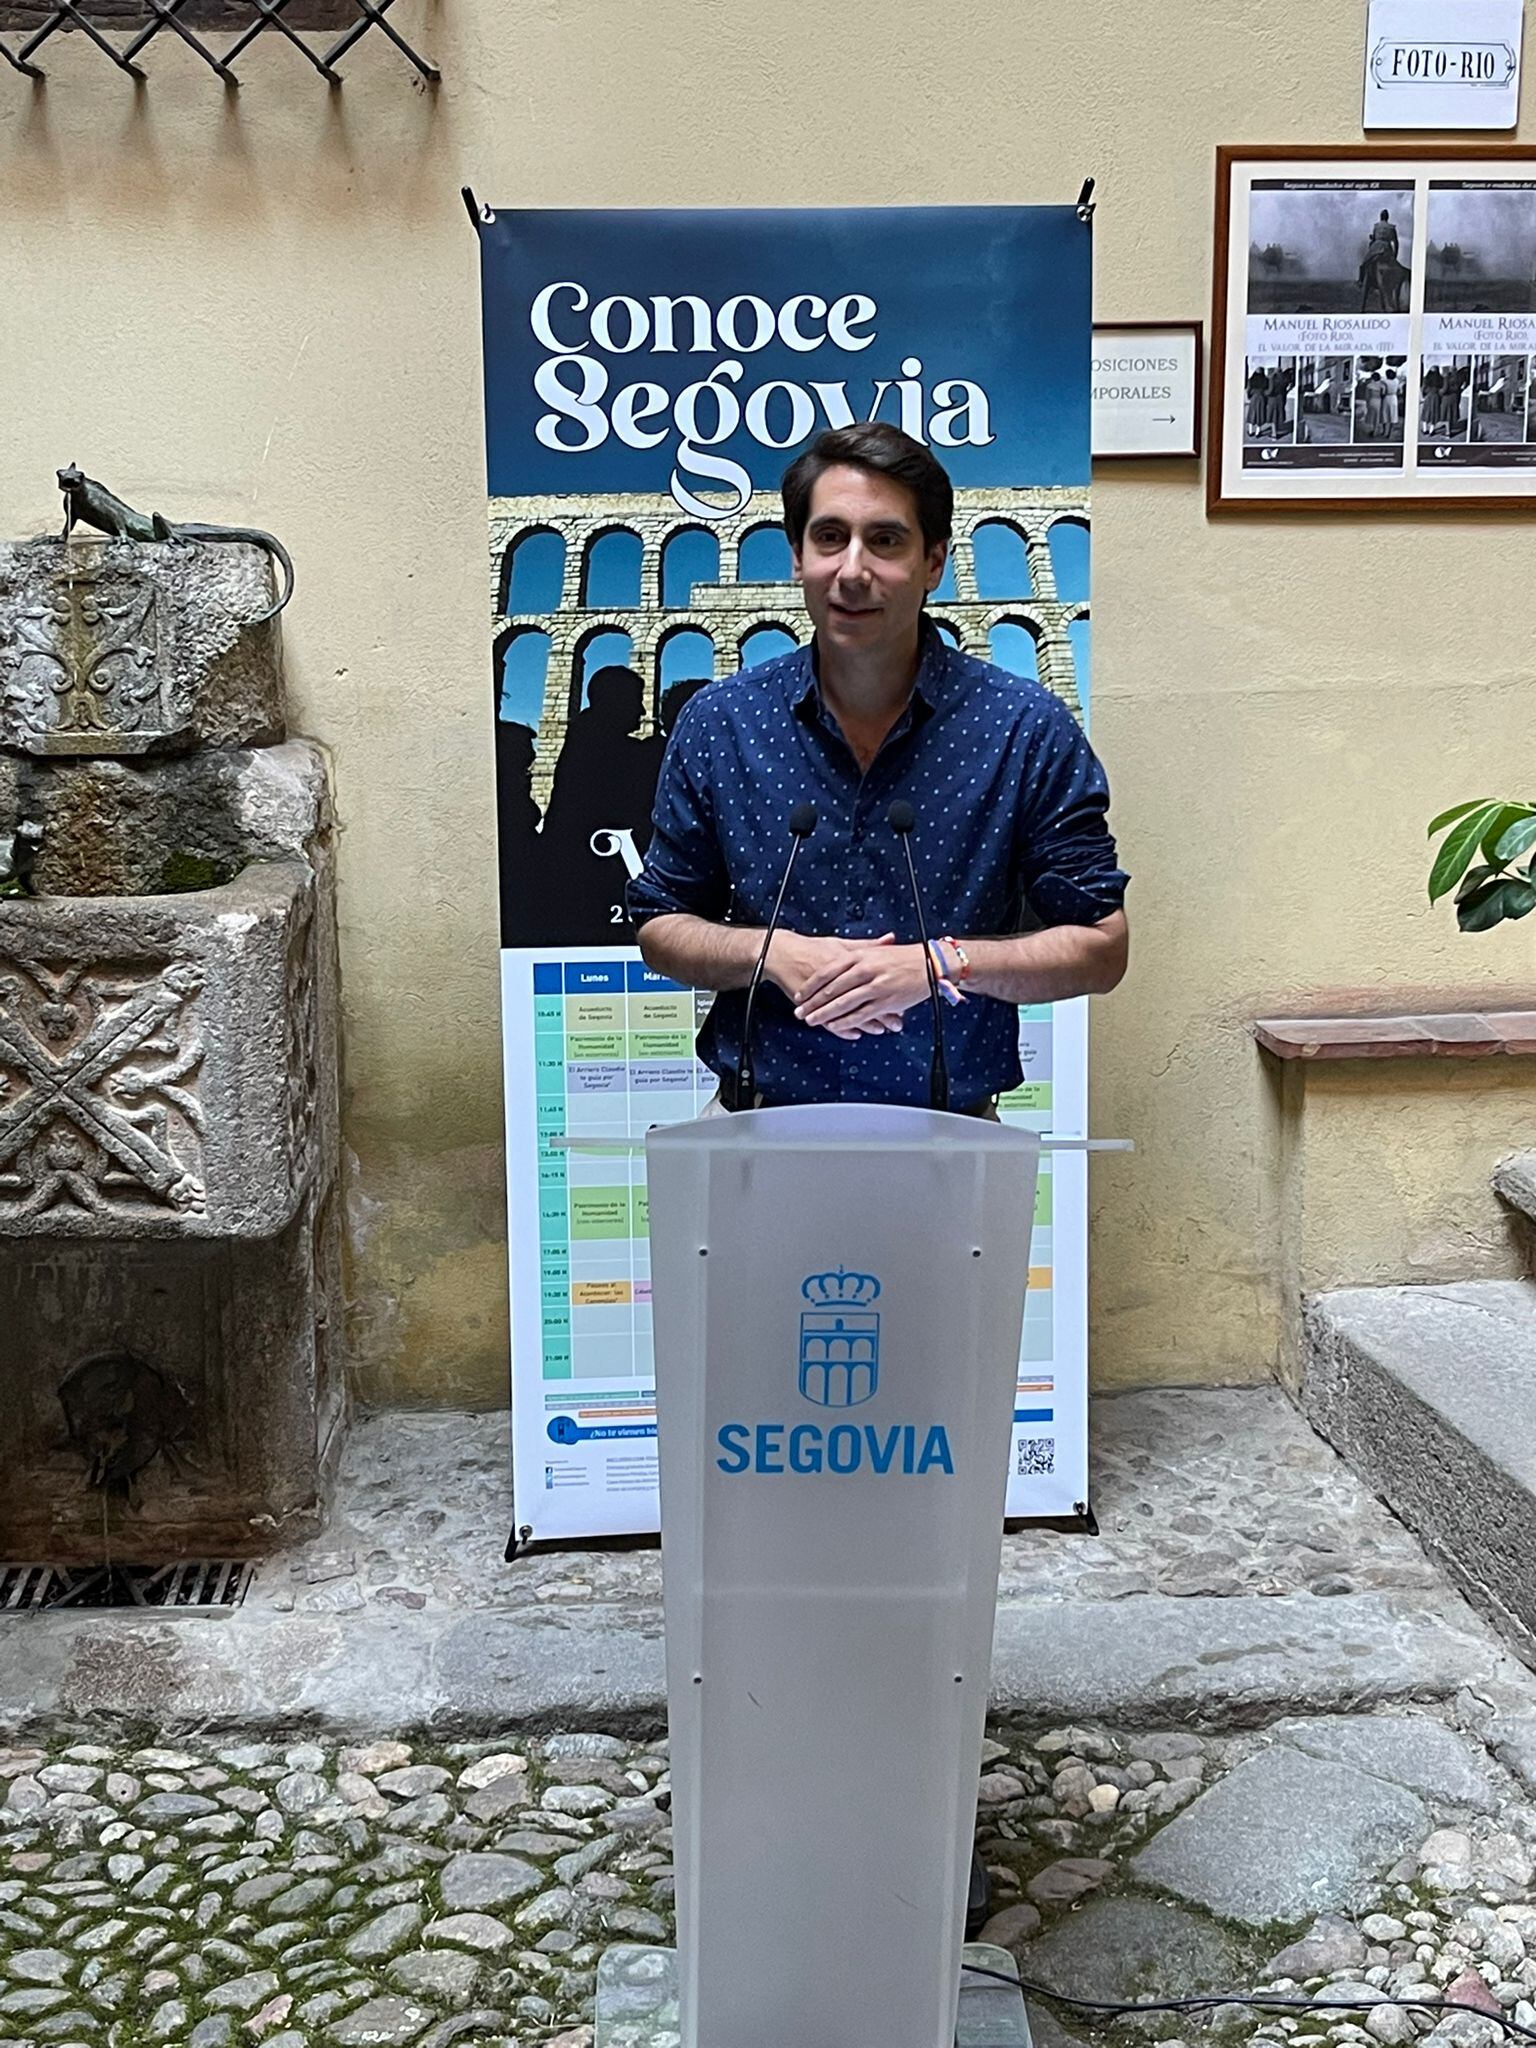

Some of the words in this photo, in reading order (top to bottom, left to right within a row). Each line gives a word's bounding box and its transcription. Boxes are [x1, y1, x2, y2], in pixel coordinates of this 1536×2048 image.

[1392, 48, 1494, 79] FOTO-RIO
[530, 281, 878, 354] Conoce
[1509, 342, 1536, 351] MIRA
[532, 354, 996, 520] Segovia
[580, 974, 609, 982] Lunes
[717, 1424, 954, 1474] SEGOVIA
